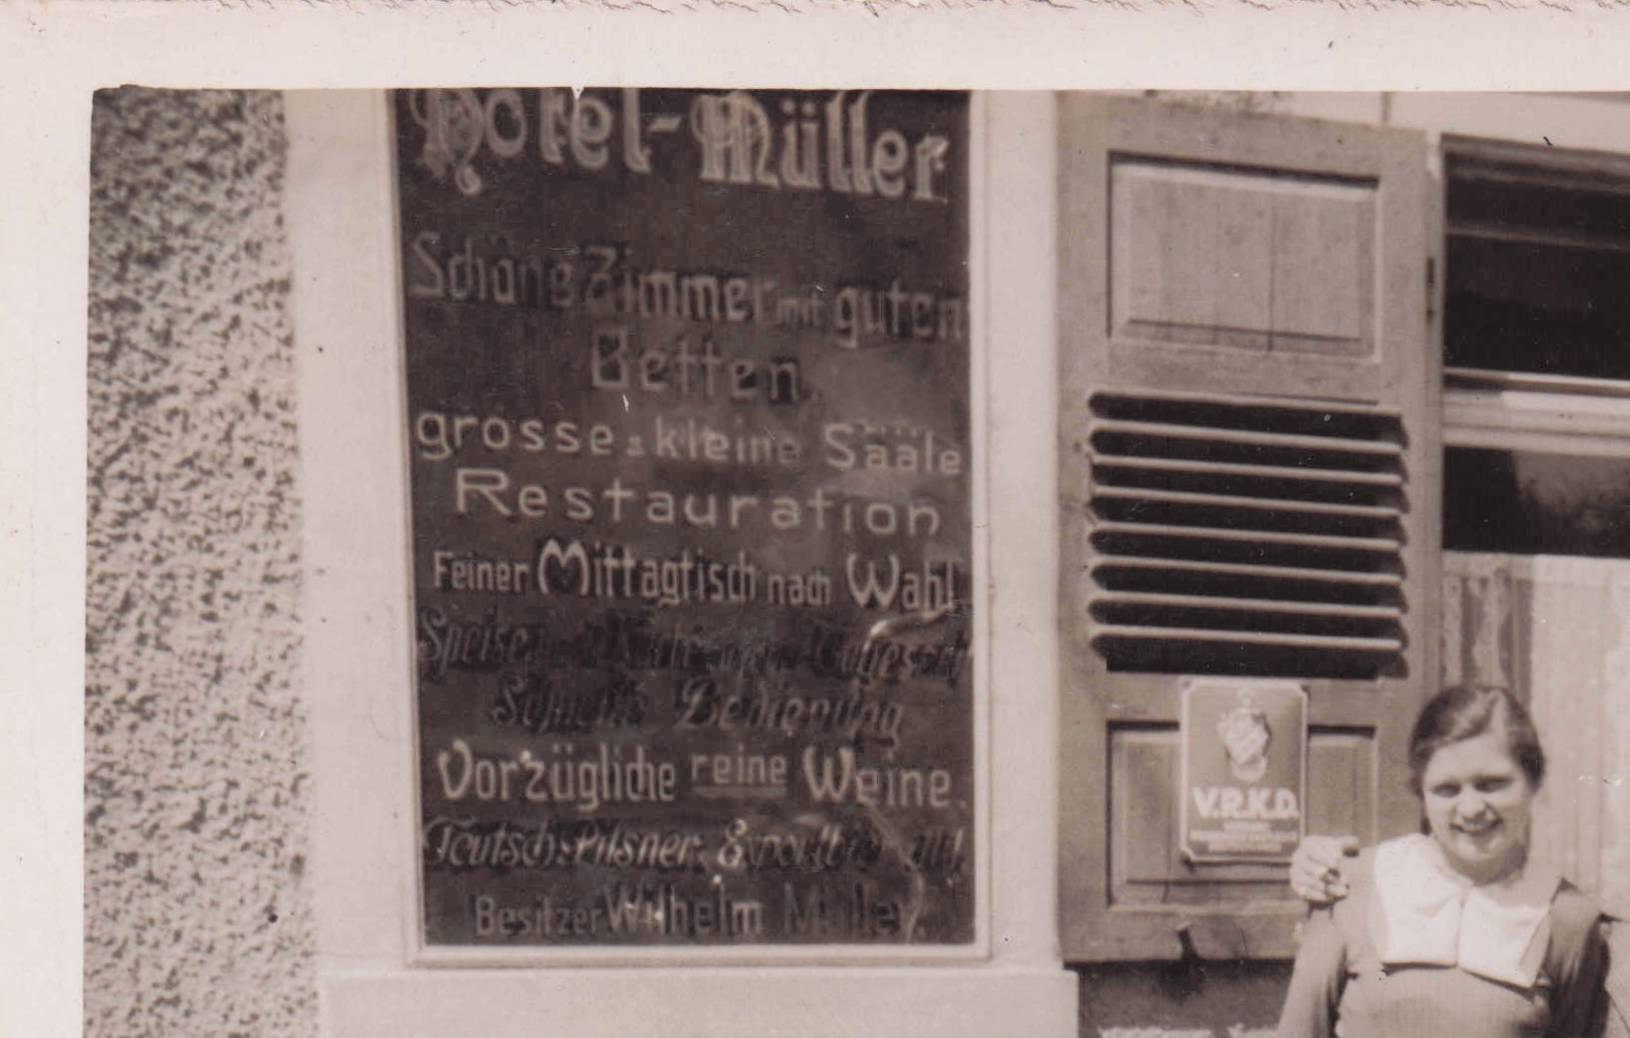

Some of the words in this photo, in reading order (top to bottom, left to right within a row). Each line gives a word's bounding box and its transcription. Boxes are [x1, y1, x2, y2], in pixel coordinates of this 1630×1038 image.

[585, 245, 774, 322] Zimmer
[836, 278, 963, 349] guten
[592, 324, 799, 402] Betten
[416, 407, 614, 461] grosse
[654, 415, 801, 464] kleine
[456, 466, 941, 537] Restauration
[432, 550, 529, 593] Feiner
[537, 539, 756, 605] Mittagtisch
[767, 573, 832, 607] nach
[846, 552, 957, 612] Wahl
[438, 738, 676, 813] Vorzügliche
[691, 748, 788, 785] reine
[474, 895, 603, 936] Besitzer
[603, 878, 764, 937] Wilhelm
